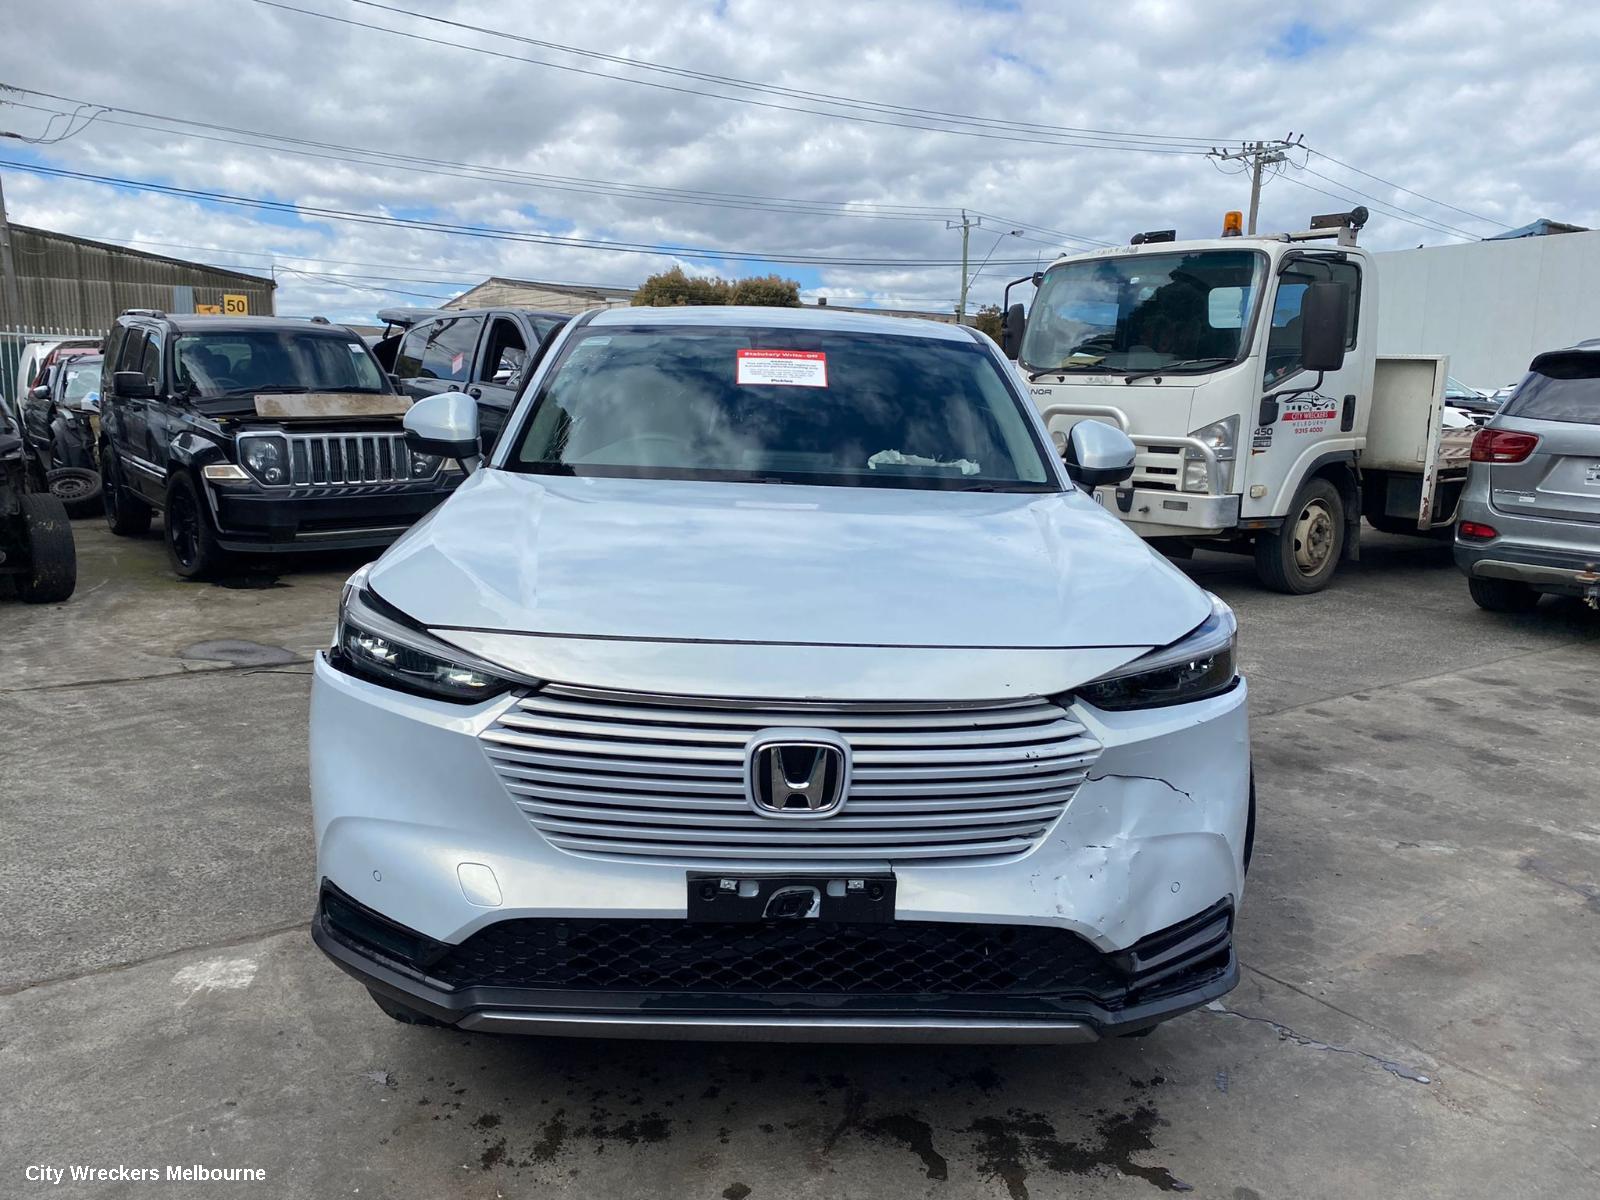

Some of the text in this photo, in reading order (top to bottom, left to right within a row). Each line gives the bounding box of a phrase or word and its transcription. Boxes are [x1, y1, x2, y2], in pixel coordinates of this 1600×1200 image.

[227, 299, 245, 313] 50
[1291, 410, 1329, 420] CITY WRECKERS
[1254, 427, 1273, 436] 450
